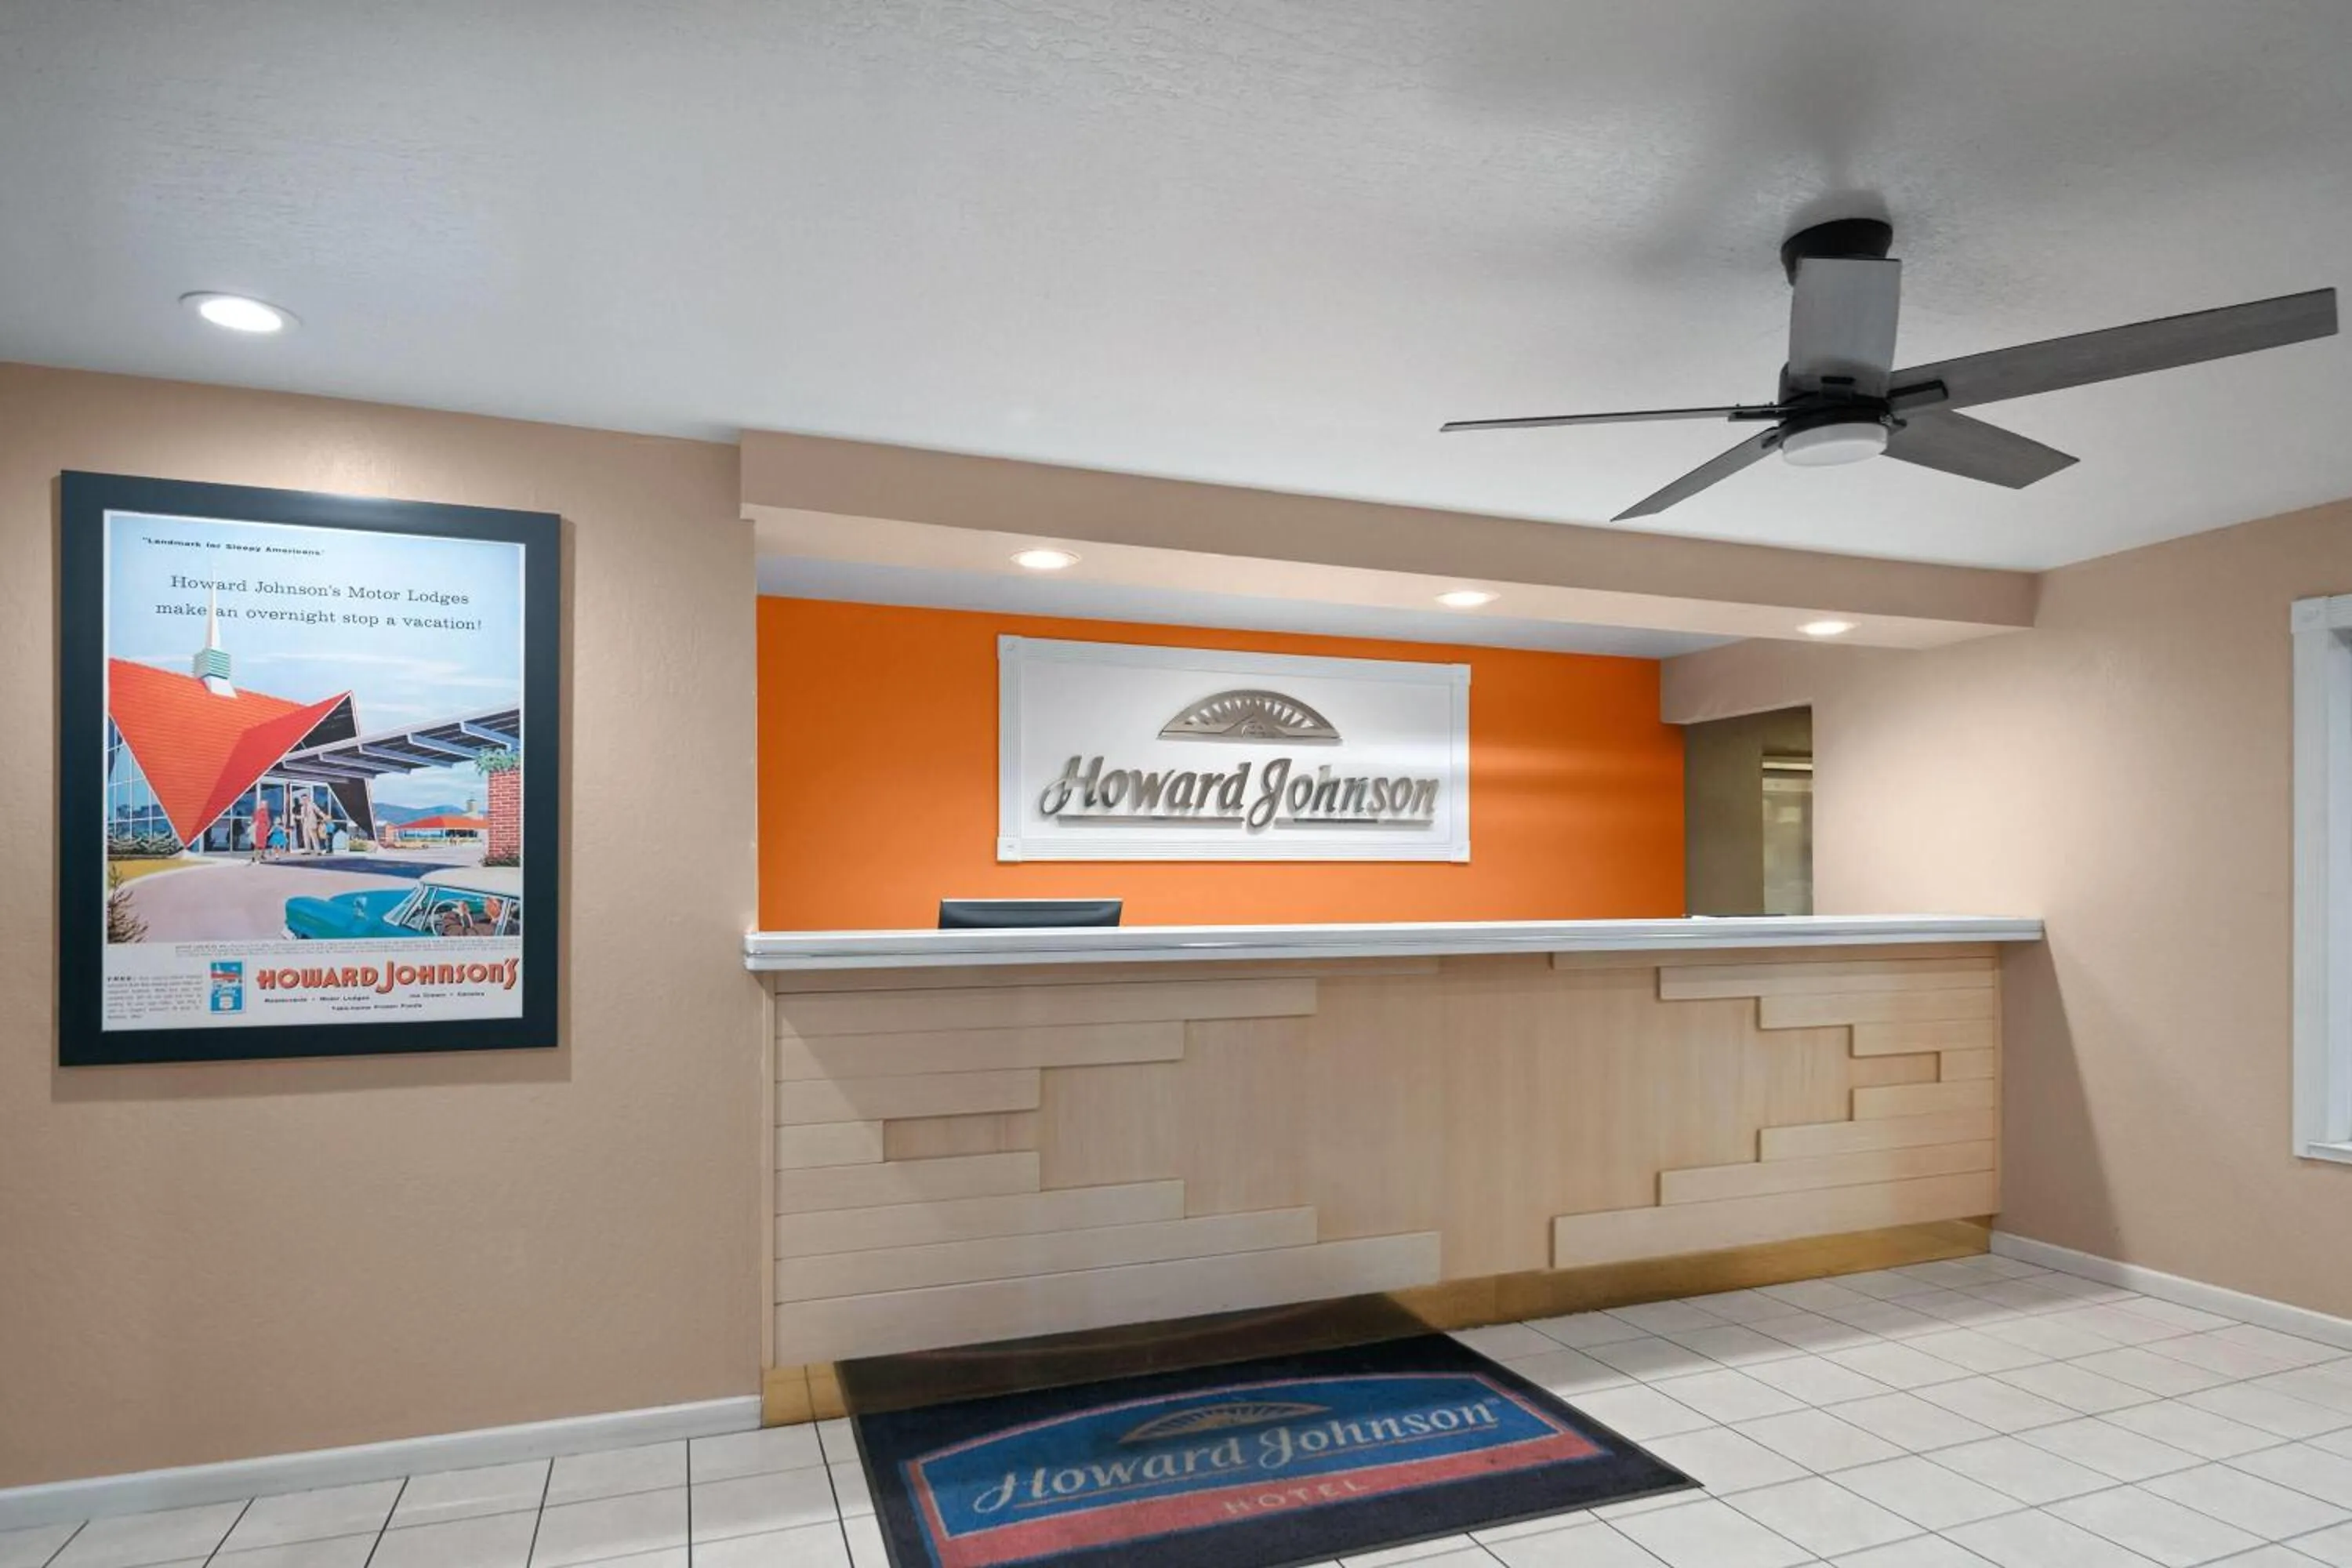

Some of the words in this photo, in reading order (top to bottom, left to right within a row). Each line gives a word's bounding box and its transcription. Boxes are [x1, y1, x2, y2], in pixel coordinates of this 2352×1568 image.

[226, 543, 261, 553] Sleepy
[171, 575, 247, 592] Howard
[255, 581, 340, 597] Johnson's
[348, 586, 400, 600] Motor
[408, 590, 470, 605] Lodges
[155, 603, 207, 615] make
[216, 608, 238, 618] an
[246, 608, 336, 624] overnight
[343, 612, 379, 627] stop
[387, 616, 396, 626] a
[402, 618, 481, 630] vacation!
[1040, 755, 1251, 818] Howard
[1246, 758, 1439, 833] Johnson
[256, 967, 379, 989] HOWARD
[376, 957, 519, 994] JOHNSON'S
[973, 1439, 1248, 1513] Howard
[1258, 1402, 1499, 1470] Johnson
[1223, 1479, 1371, 1516] HOTEL
